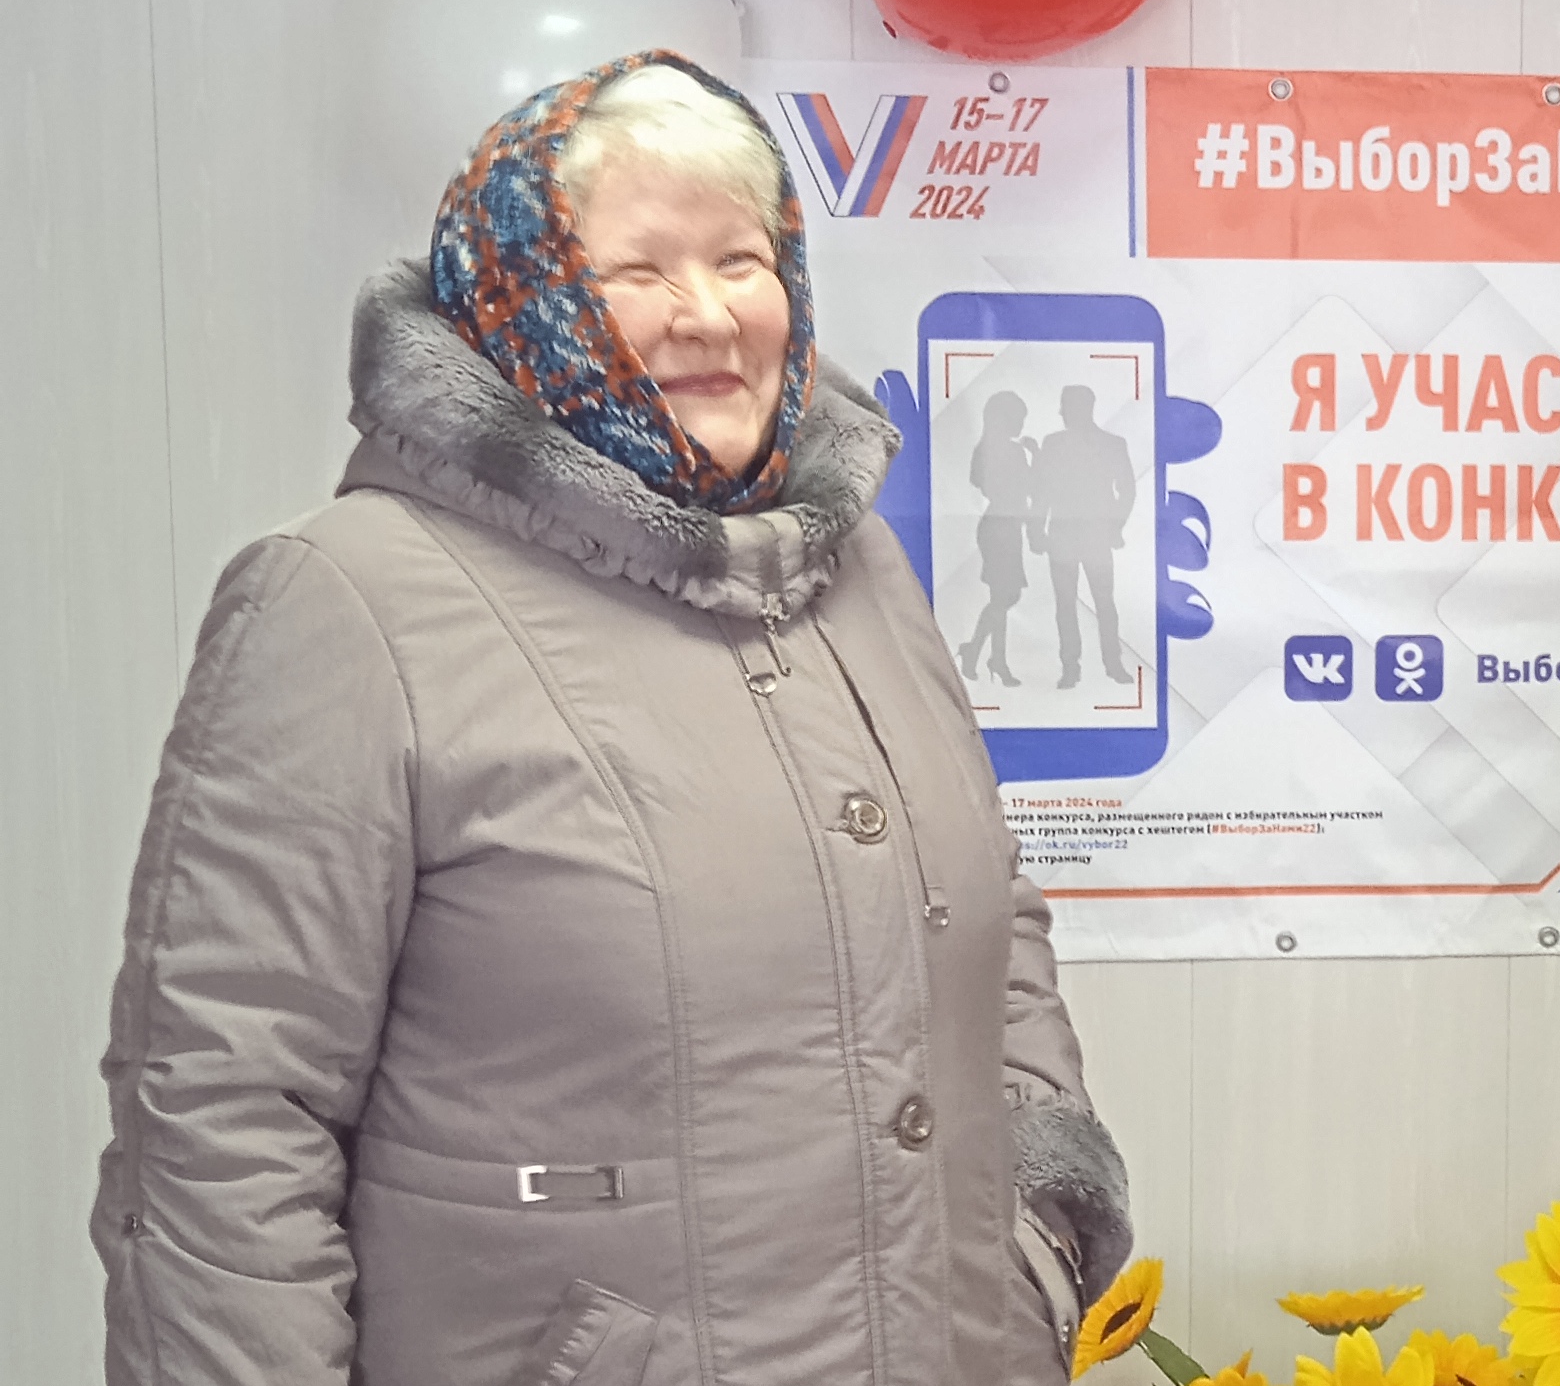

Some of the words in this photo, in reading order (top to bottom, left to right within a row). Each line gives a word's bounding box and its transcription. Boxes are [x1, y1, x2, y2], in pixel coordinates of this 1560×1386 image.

[927, 140, 1041, 176] МАРТА
[909, 183, 990, 220] 2024
[1288, 353, 1337, 433] Я
[1283, 462, 1328, 542] В
[1011, 798, 1025, 808] 17
[1027, 799, 1063, 809] марта
[1065, 797, 1093, 808] 2024
[1096, 798, 1123, 809] года
[1037, 812, 1095, 823] конкурса,
[1098, 812, 1184, 823] размещенного
[1187, 811, 1224, 822] рядом
[1226, 811, 1232, 820] с
[1235, 809, 1327, 822] избирательным
[1329, 811, 1384, 822] участком
[1038, 826, 1079, 838] группа
[1081, 825, 1135, 837] конкурса
[1138, 825, 1144, 835] с
[1147, 824, 1205, 836] хештегом
[1038, 854, 1093, 865] страницу
